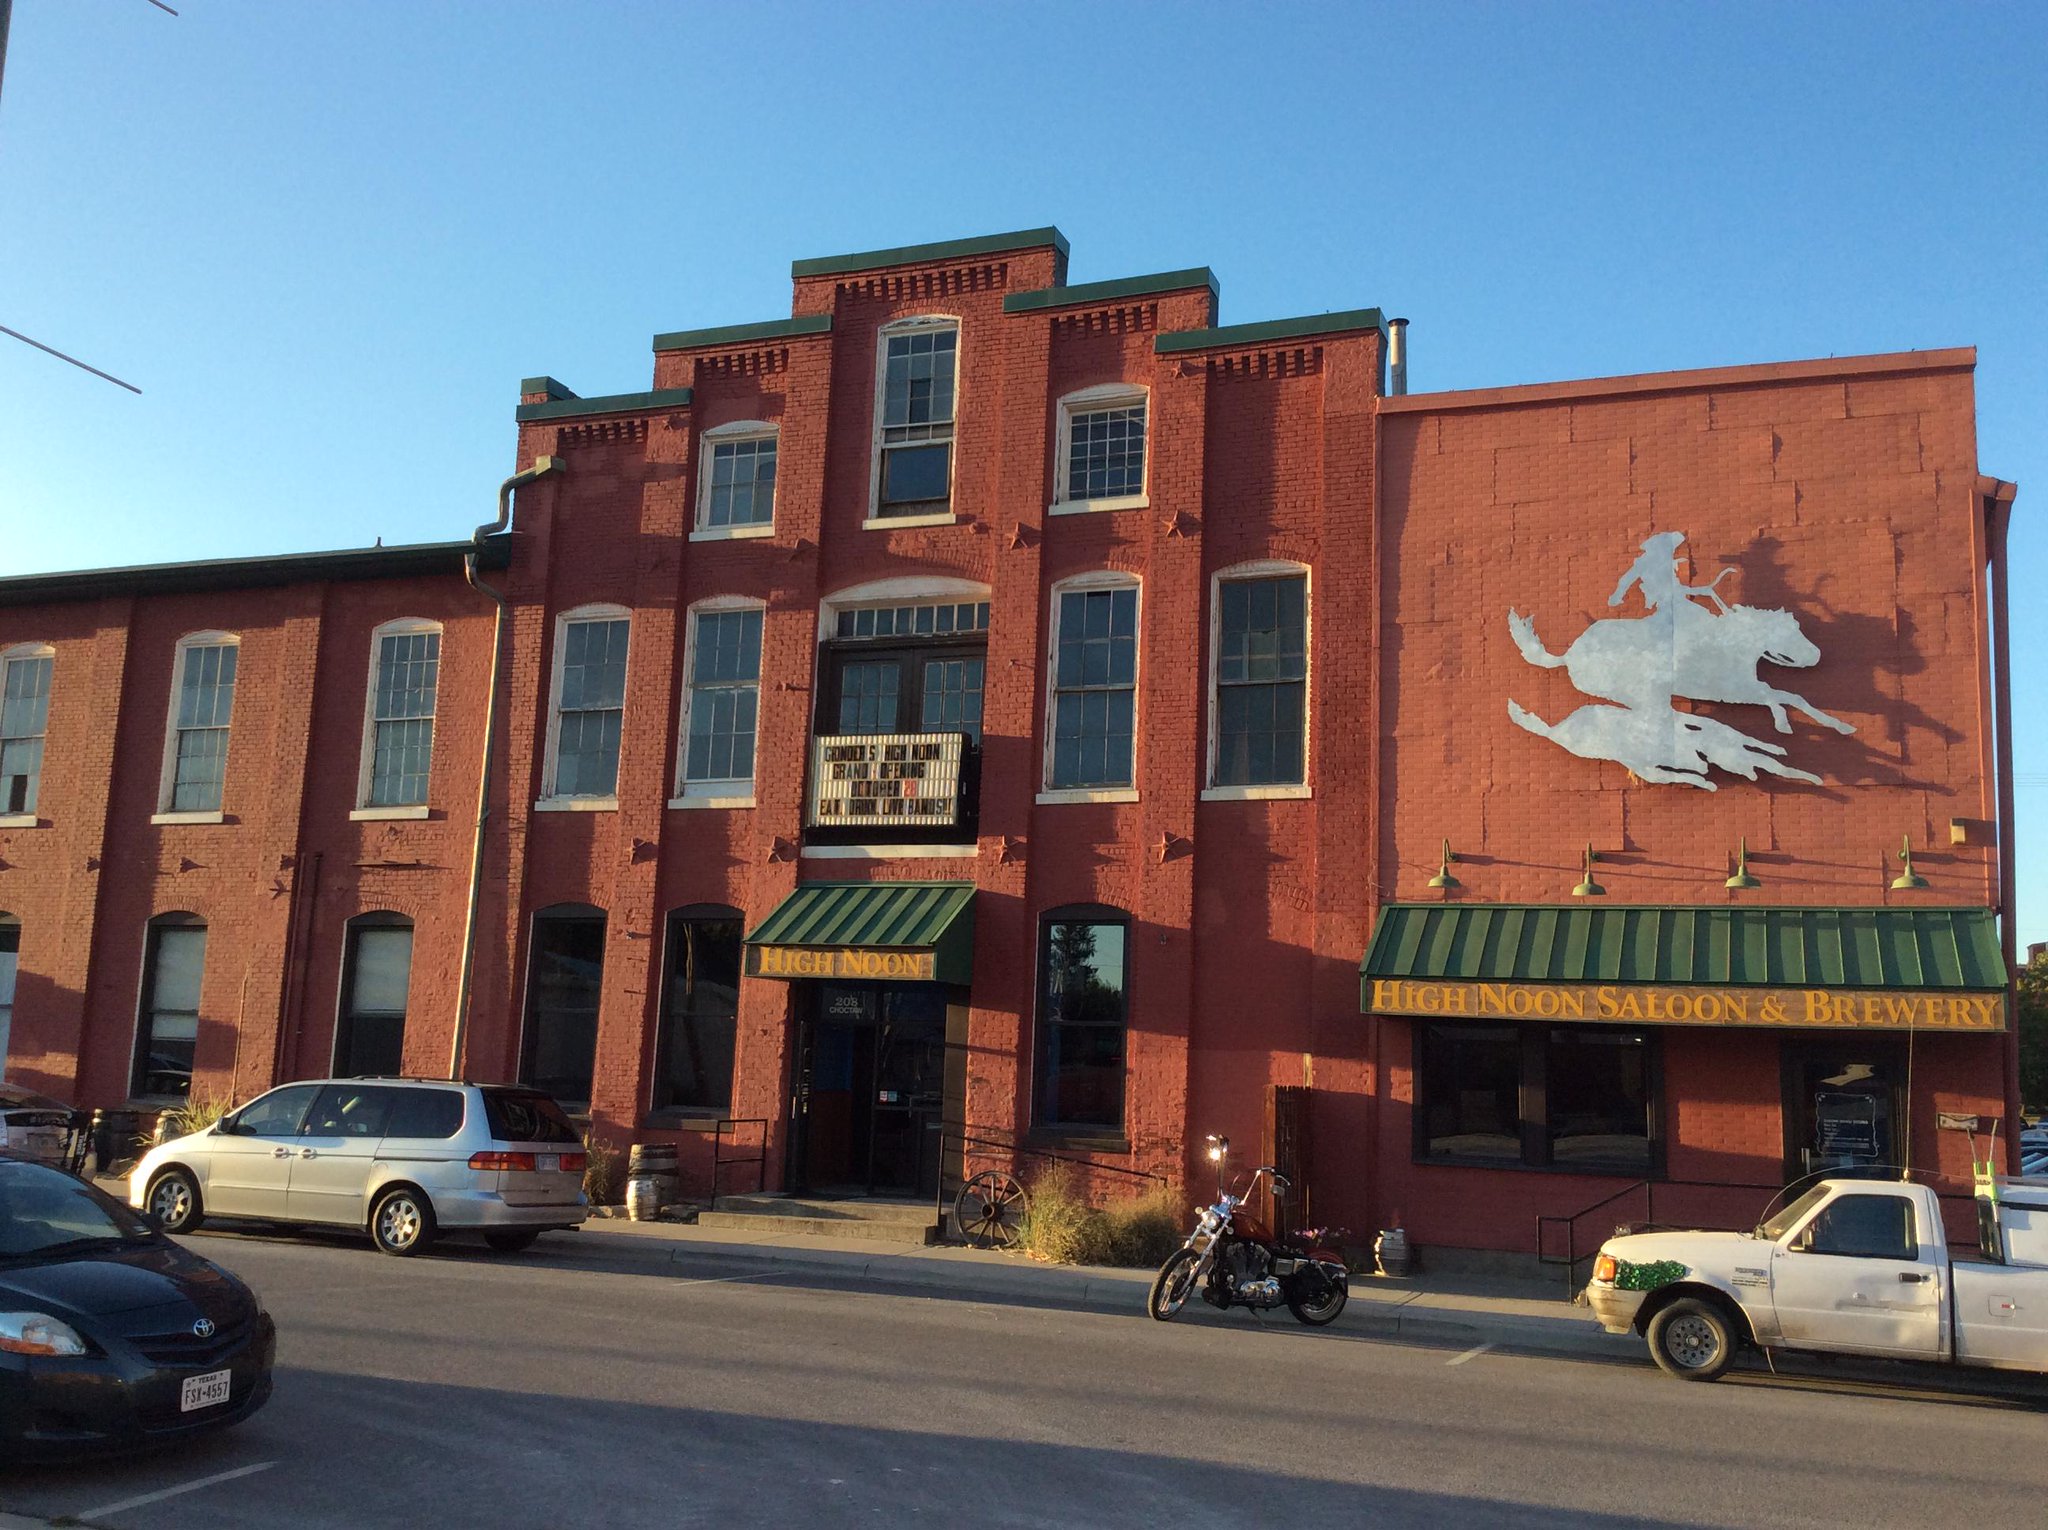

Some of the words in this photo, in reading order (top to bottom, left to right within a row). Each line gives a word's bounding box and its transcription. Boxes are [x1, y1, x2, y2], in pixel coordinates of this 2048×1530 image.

[884, 744, 907, 761] HIGH
[911, 743, 940, 760] NOON
[833, 763, 868, 779] GRAND
[880, 761, 925, 779] OPENING
[850, 780, 901, 798] OCTOBER
[882, 798, 905, 816] LIVE
[759, 946, 835, 975] HIGH
[842, 947, 921, 977] NOON
[834, 996, 859, 1007] 208
[1371, 979, 1467, 1014] HIGH
[1478, 982, 1586, 1018] NOON
[1598, 985, 1749, 1023] SALOON
[1760, 995, 1792, 1024] &
[1803, 990, 2000, 1026] BREWERY
